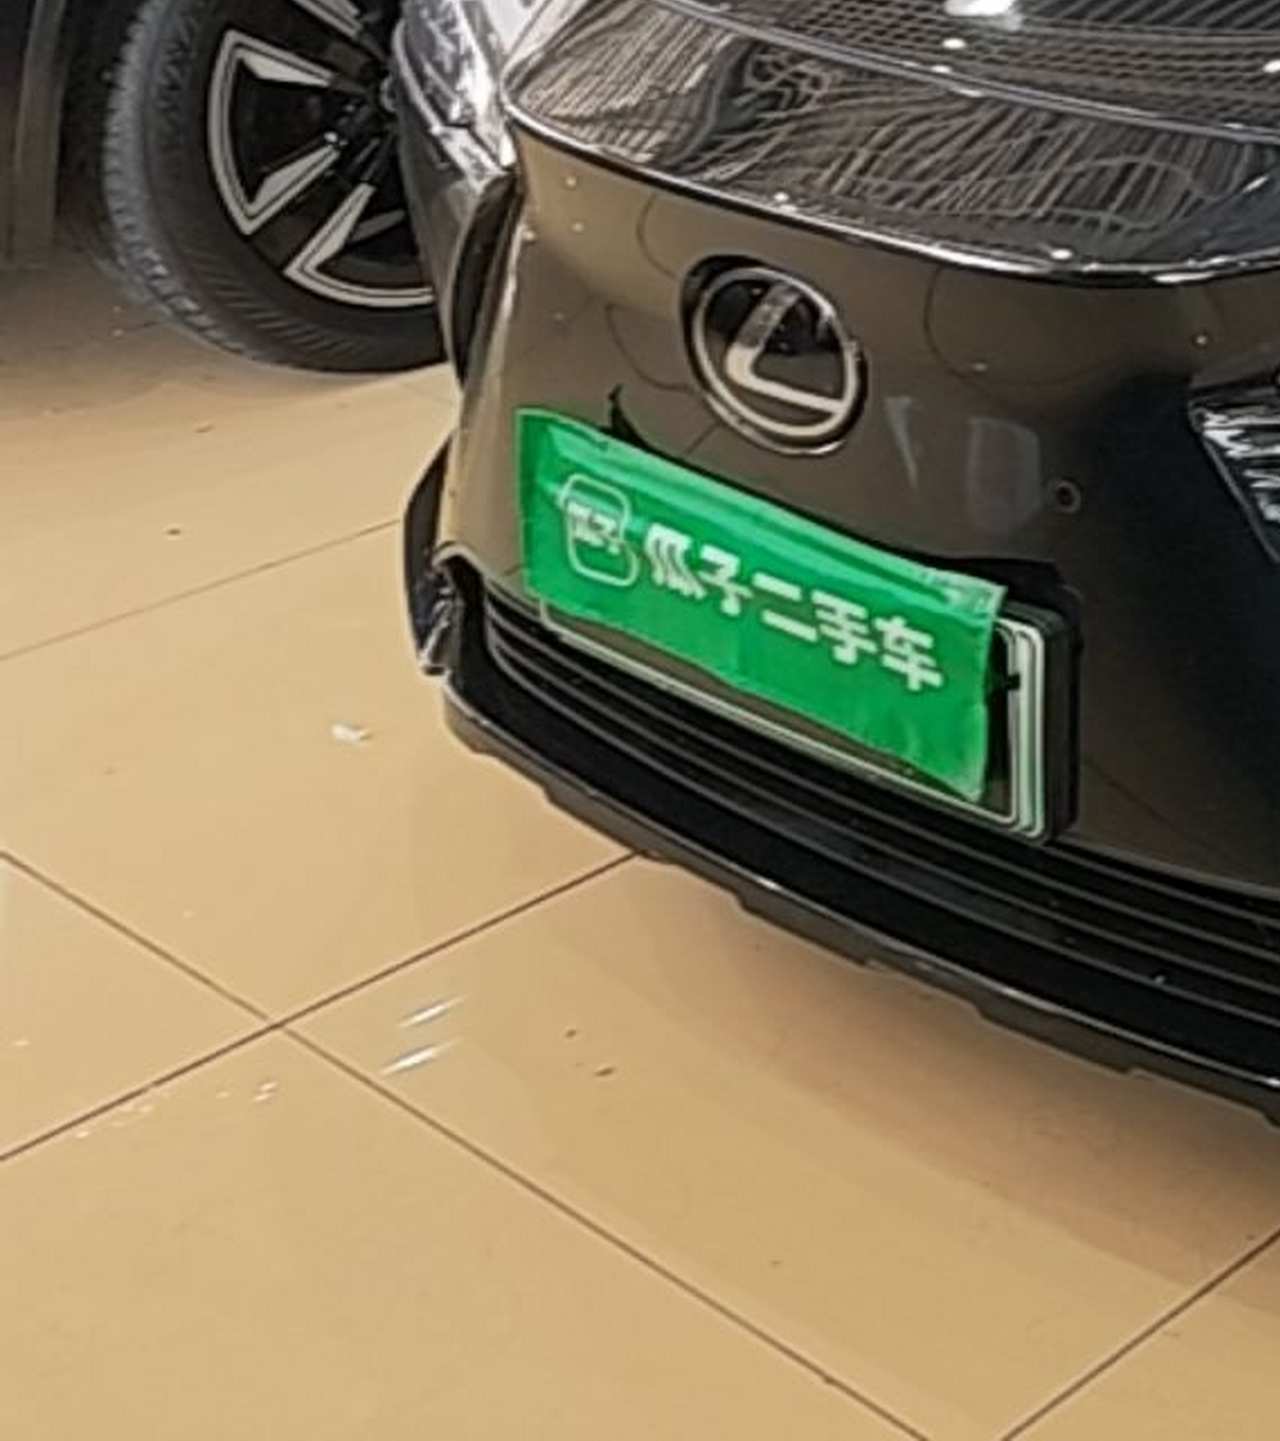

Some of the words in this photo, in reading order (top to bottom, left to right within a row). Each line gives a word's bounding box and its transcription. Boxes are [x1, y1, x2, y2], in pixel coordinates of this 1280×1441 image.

[644, 521, 945, 692] 瓜子二手车
